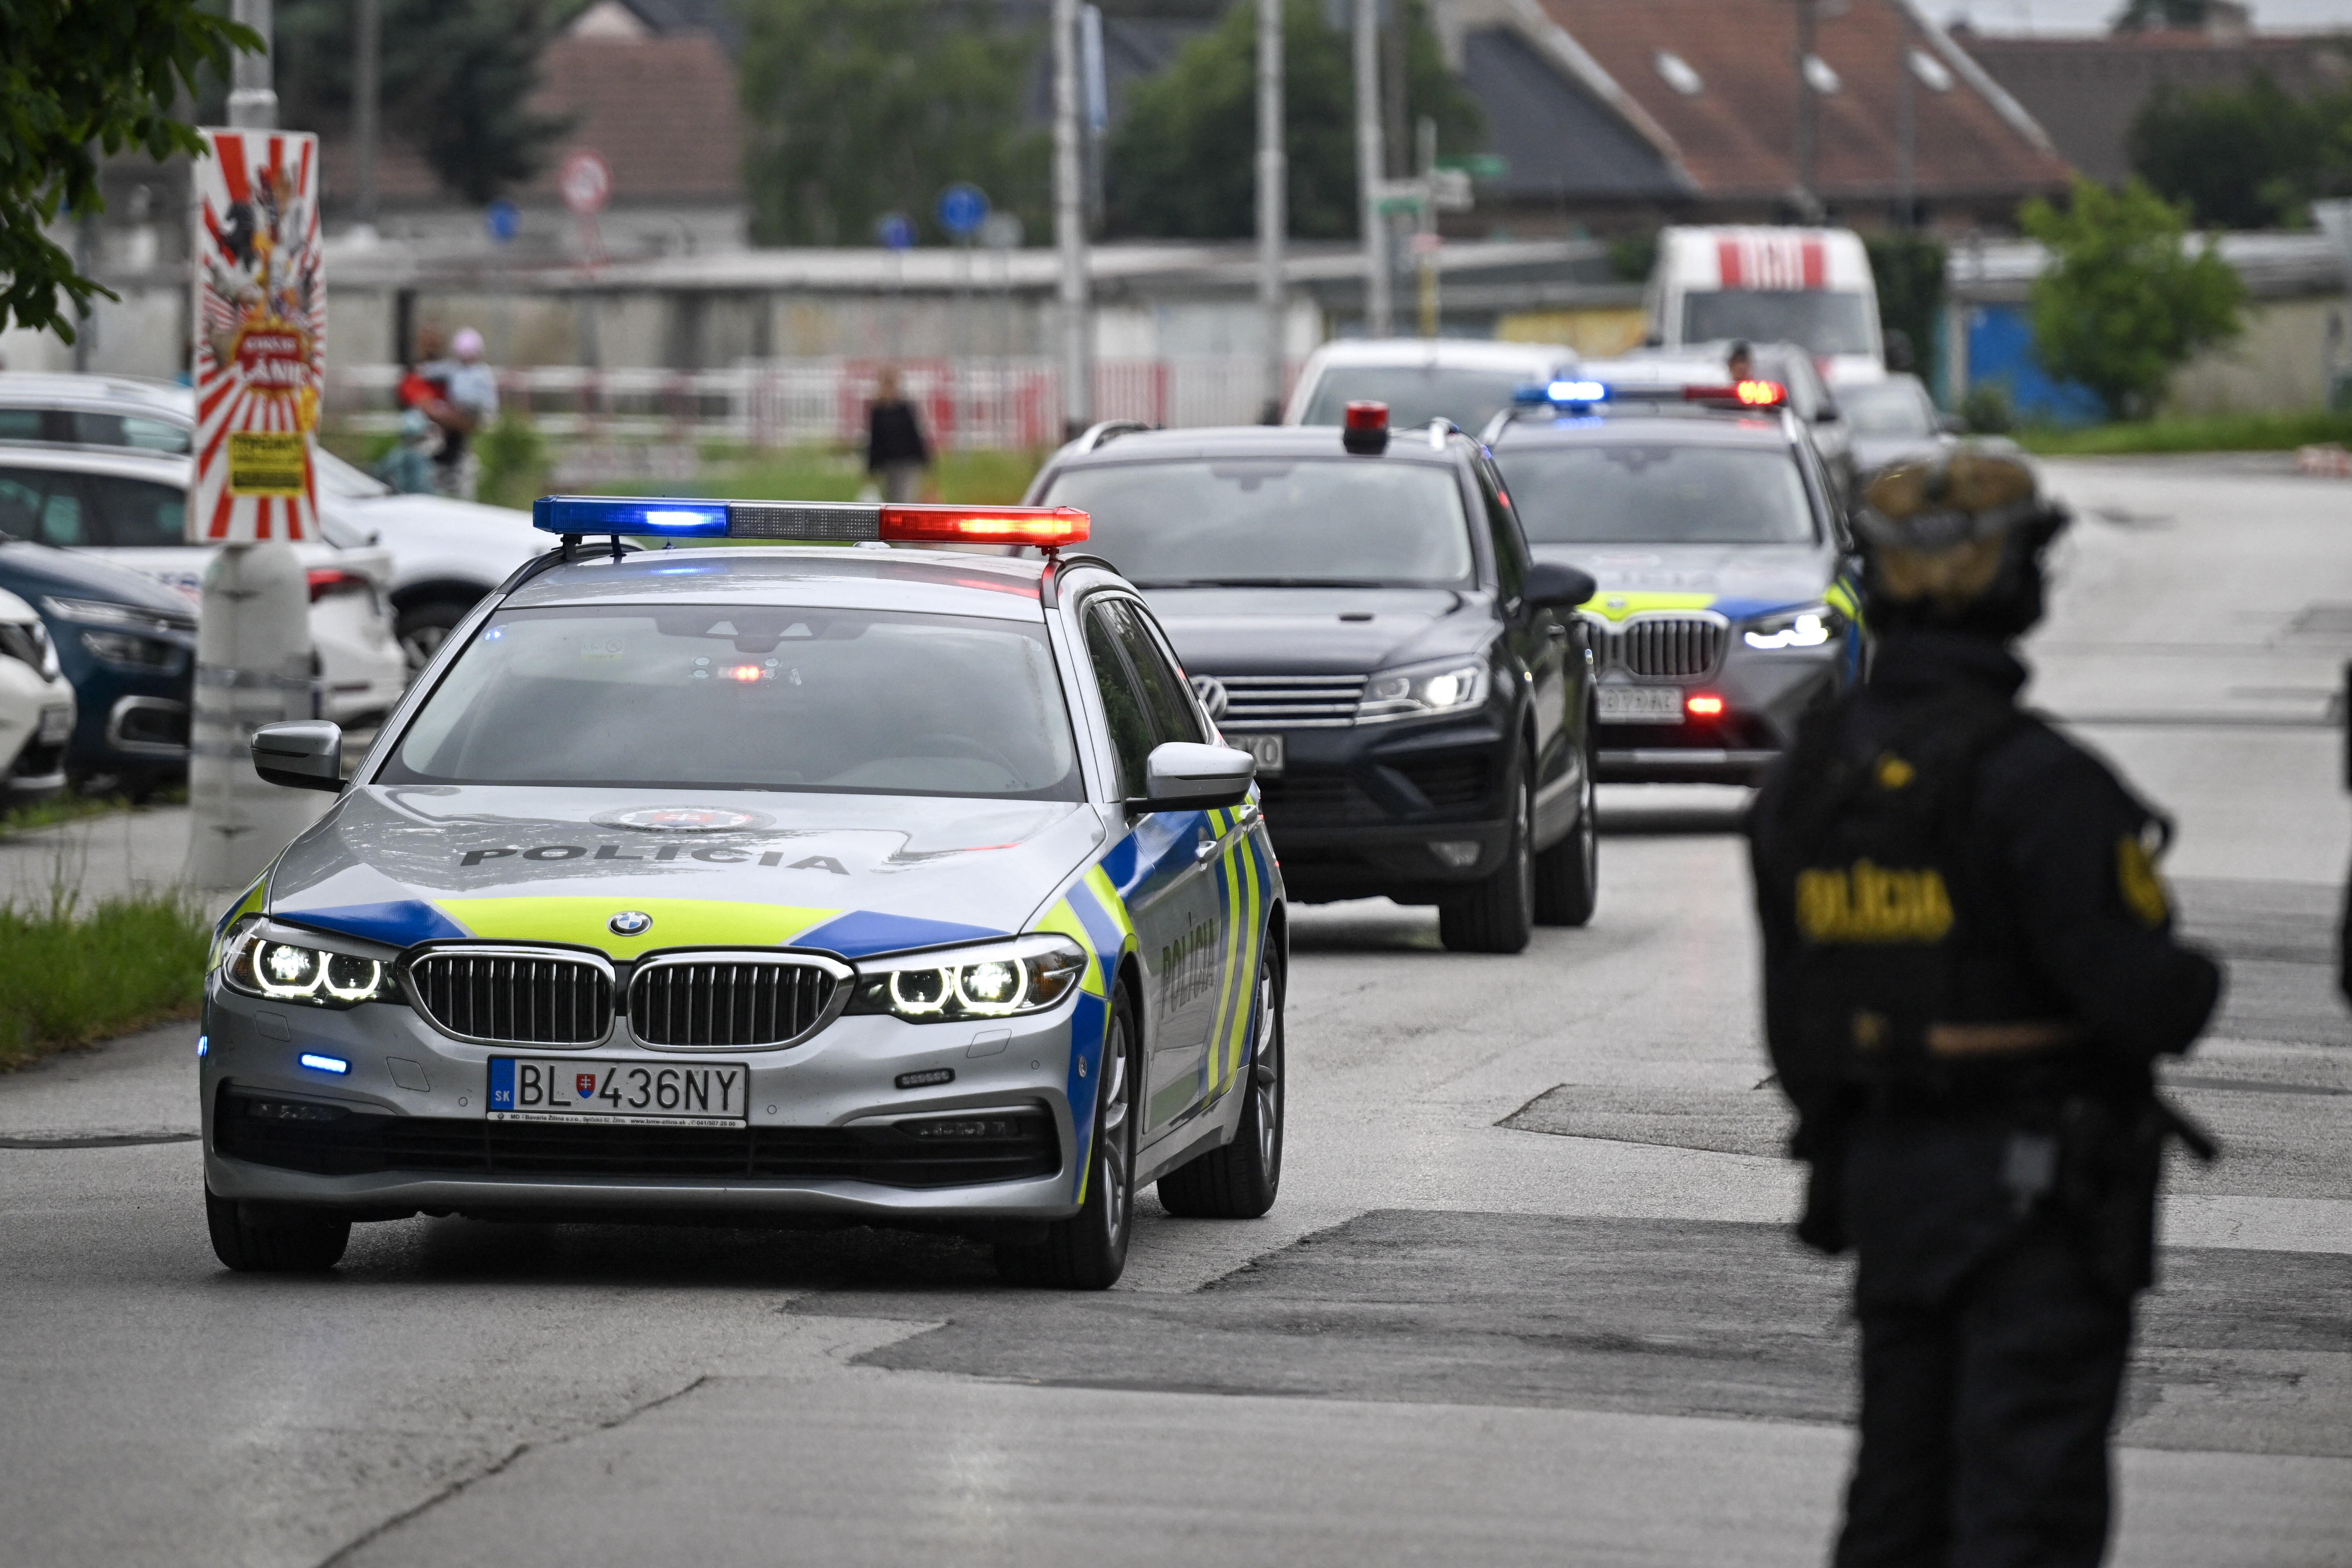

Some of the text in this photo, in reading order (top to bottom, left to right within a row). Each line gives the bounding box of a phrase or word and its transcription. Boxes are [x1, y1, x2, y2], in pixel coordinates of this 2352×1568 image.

[460, 844, 851, 875] POLÍCIA
[1160, 911, 1214, 1020] POLÍCIA
[495, 1090, 510, 1102] SK
